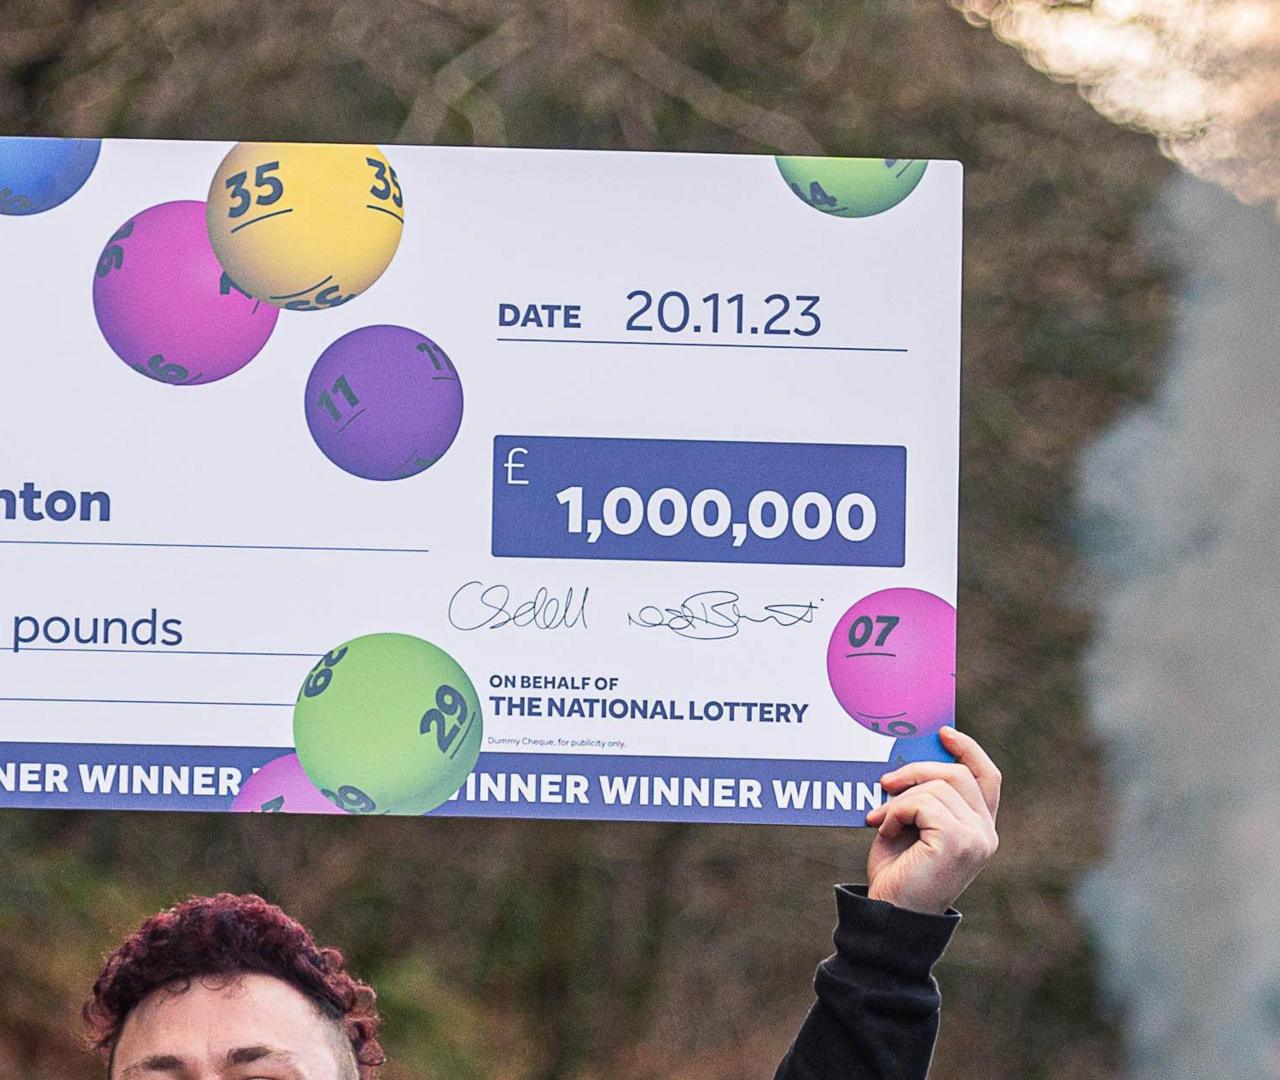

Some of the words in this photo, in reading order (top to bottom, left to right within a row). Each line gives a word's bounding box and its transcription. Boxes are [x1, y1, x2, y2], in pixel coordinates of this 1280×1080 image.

[225, 161, 284, 218] 35
[498, 303, 582, 329] DATE
[626, 289, 821, 337] 20.11.23
[318, 374, 360, 420] 11
[503, 447, 530, 485] £
[556, 486, 877, 547] 1,000,000
[13, 608, 183, 653] pounds
[848, 615, 900, 648] 07
[489, 674, 517, 689] ON
[520, 675, 591, 690] BEHALF
[594, 676, 619, 691] OF
[420, 685, 467, 753] 29
[488, 695, 543, 717] THE
[547, 697, 685, 721] NATIONAL
[688, 700, 809, 724] LOTTERY
[487, 736, 521, 746] Dummy
[557, 738, 569, 746] for
[570, 739, 606, 749] publicity
[78, 764, 241, 796] WINNER
[445, 772, 590, 804] INNER
[599, 775, 763, 808] WINNER
[772, 779, 886, 811] WINN
